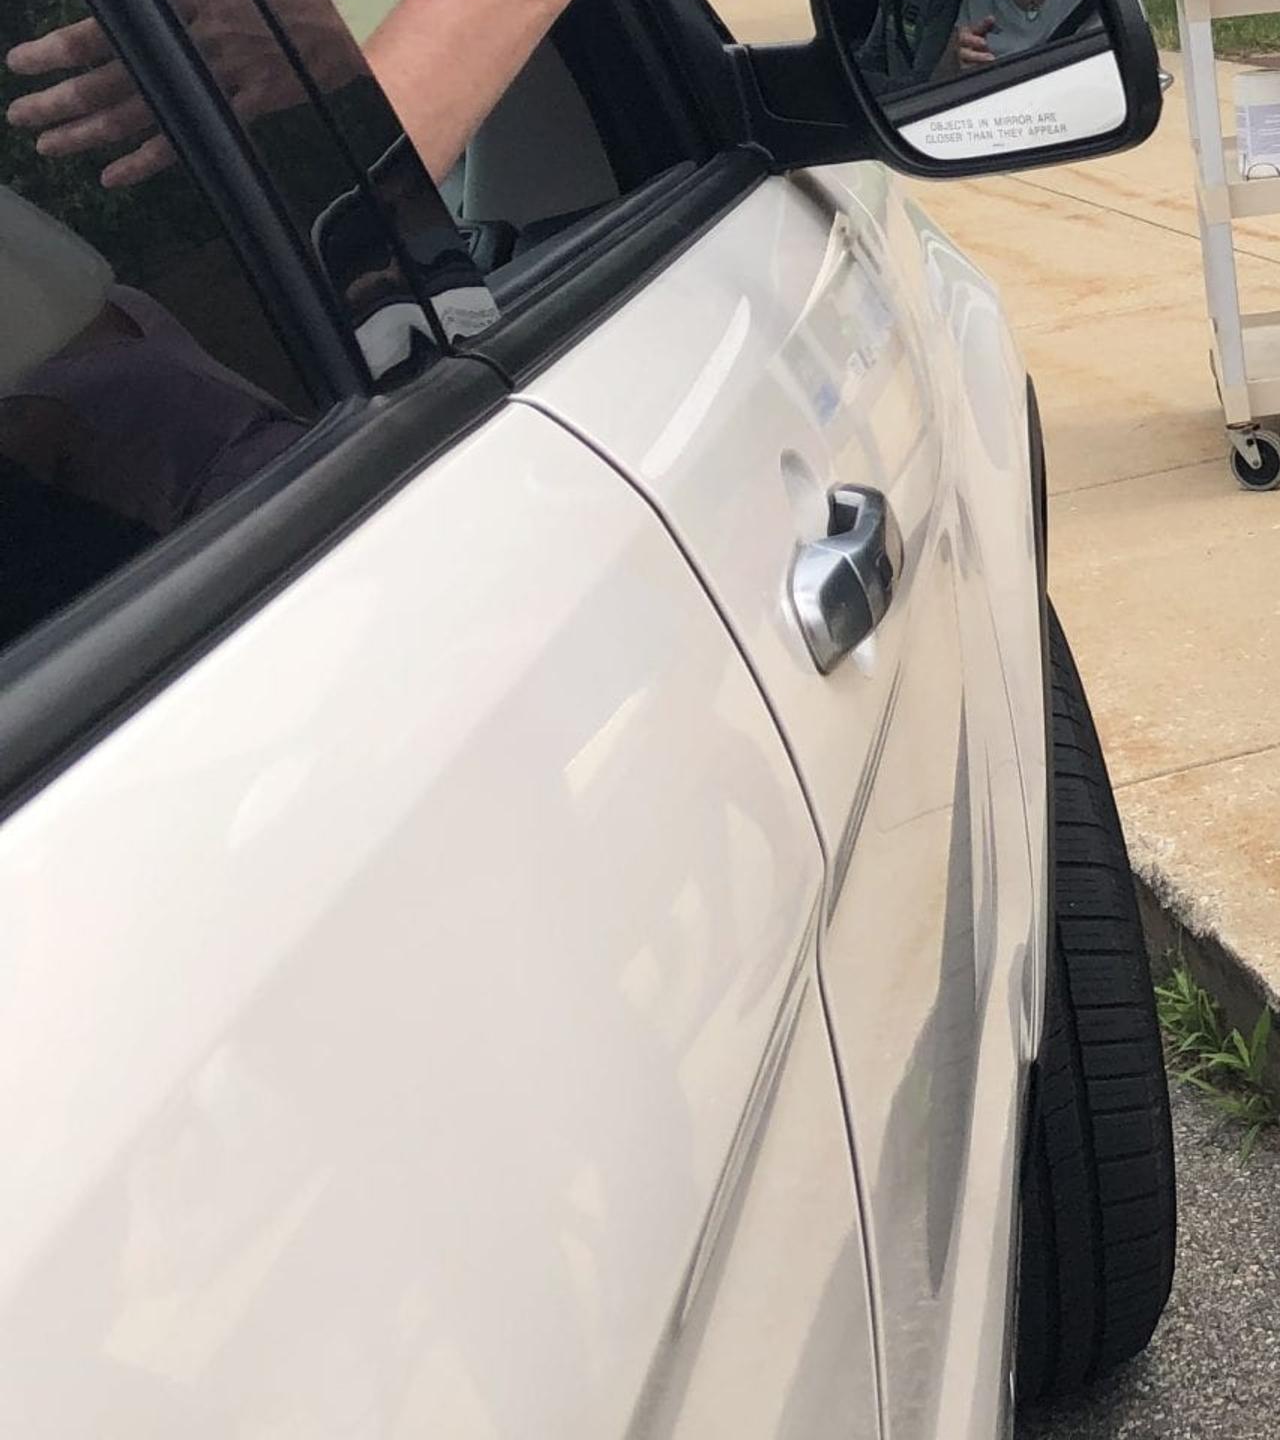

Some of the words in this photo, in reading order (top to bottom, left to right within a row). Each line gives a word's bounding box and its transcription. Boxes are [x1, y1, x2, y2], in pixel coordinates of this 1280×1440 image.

[930, 118, 973, 132] OBJECTS
[978, 119, 989, 128] IN
[994, 114, 1032, 127] MIRROR
[1037, 112, 1057, 123] ARE
[925, 132, 962, 145] CLOSER
[968, 129, 994, 142] THAN
[999, 127, 1024, 139] THEY
[1028, 122, 1068, 136] APPEAR
